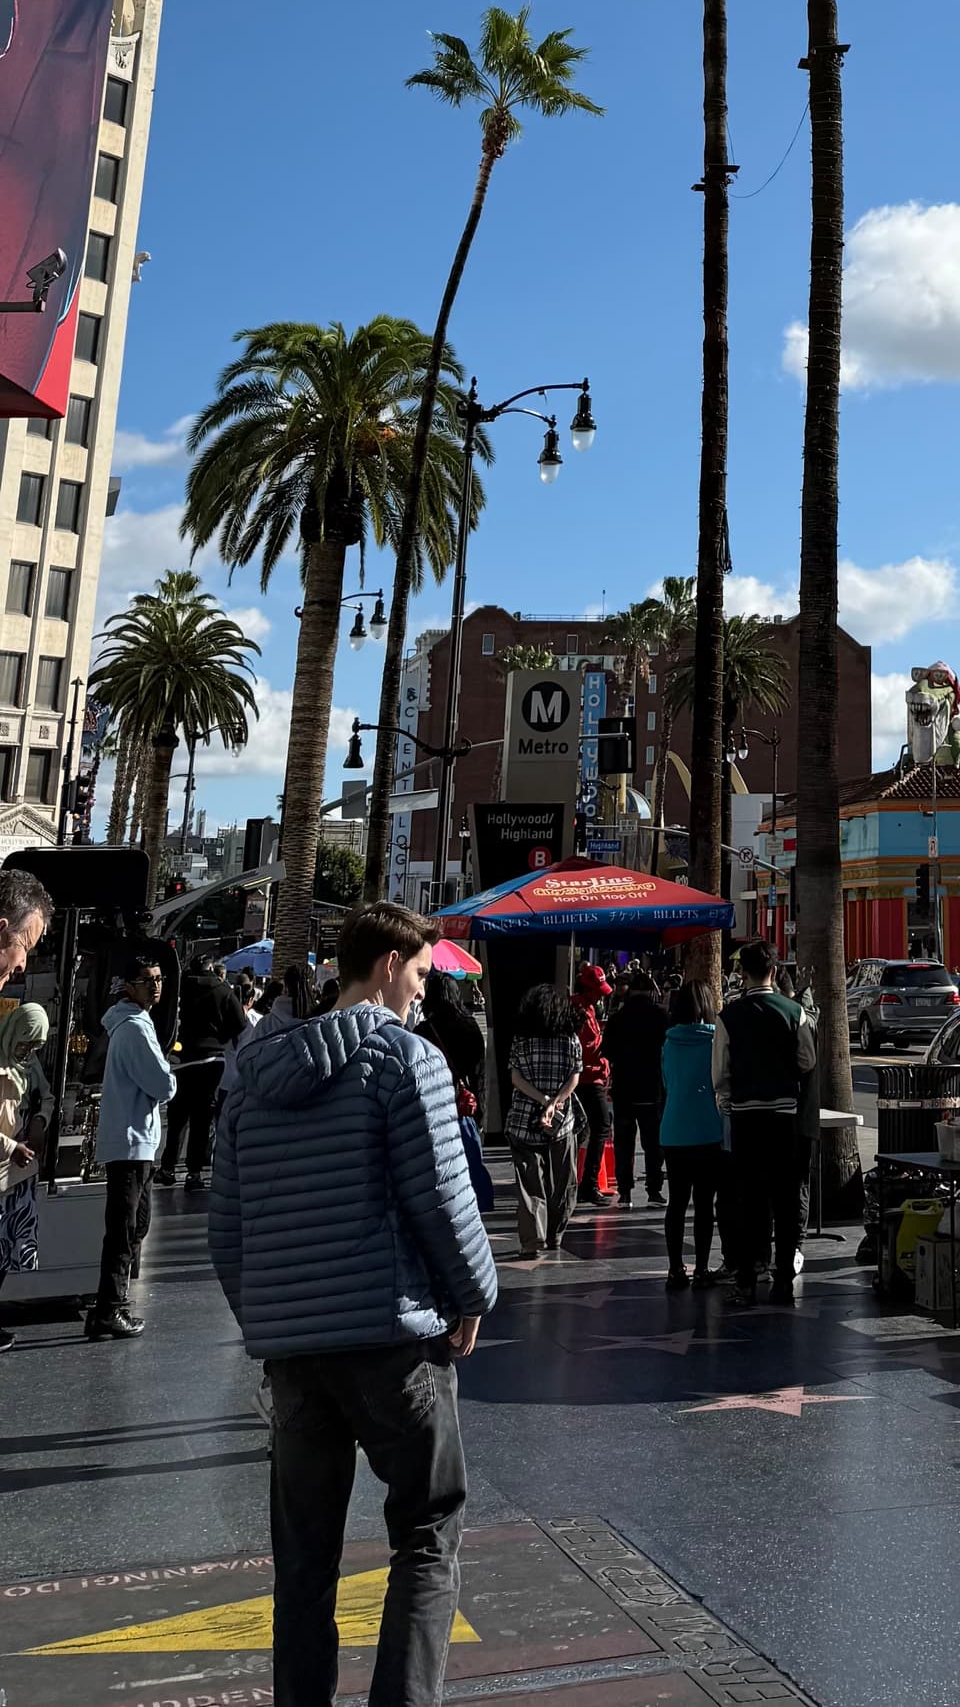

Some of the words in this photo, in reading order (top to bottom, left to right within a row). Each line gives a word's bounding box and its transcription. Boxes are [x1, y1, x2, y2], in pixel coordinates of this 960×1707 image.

[530, 691, 563, 723] M
[518, 738, 569, 755] Metro
[394, 687, 417, 885] SCIENTLOGY
[487, 813, 555, 828] Hollywood/
[501, 828, 553, 842] Highland
[534, 851, 546, 867] B
[653, 909, 699, 920] BILLETS
[4, 1580, 61, 1598] DO
